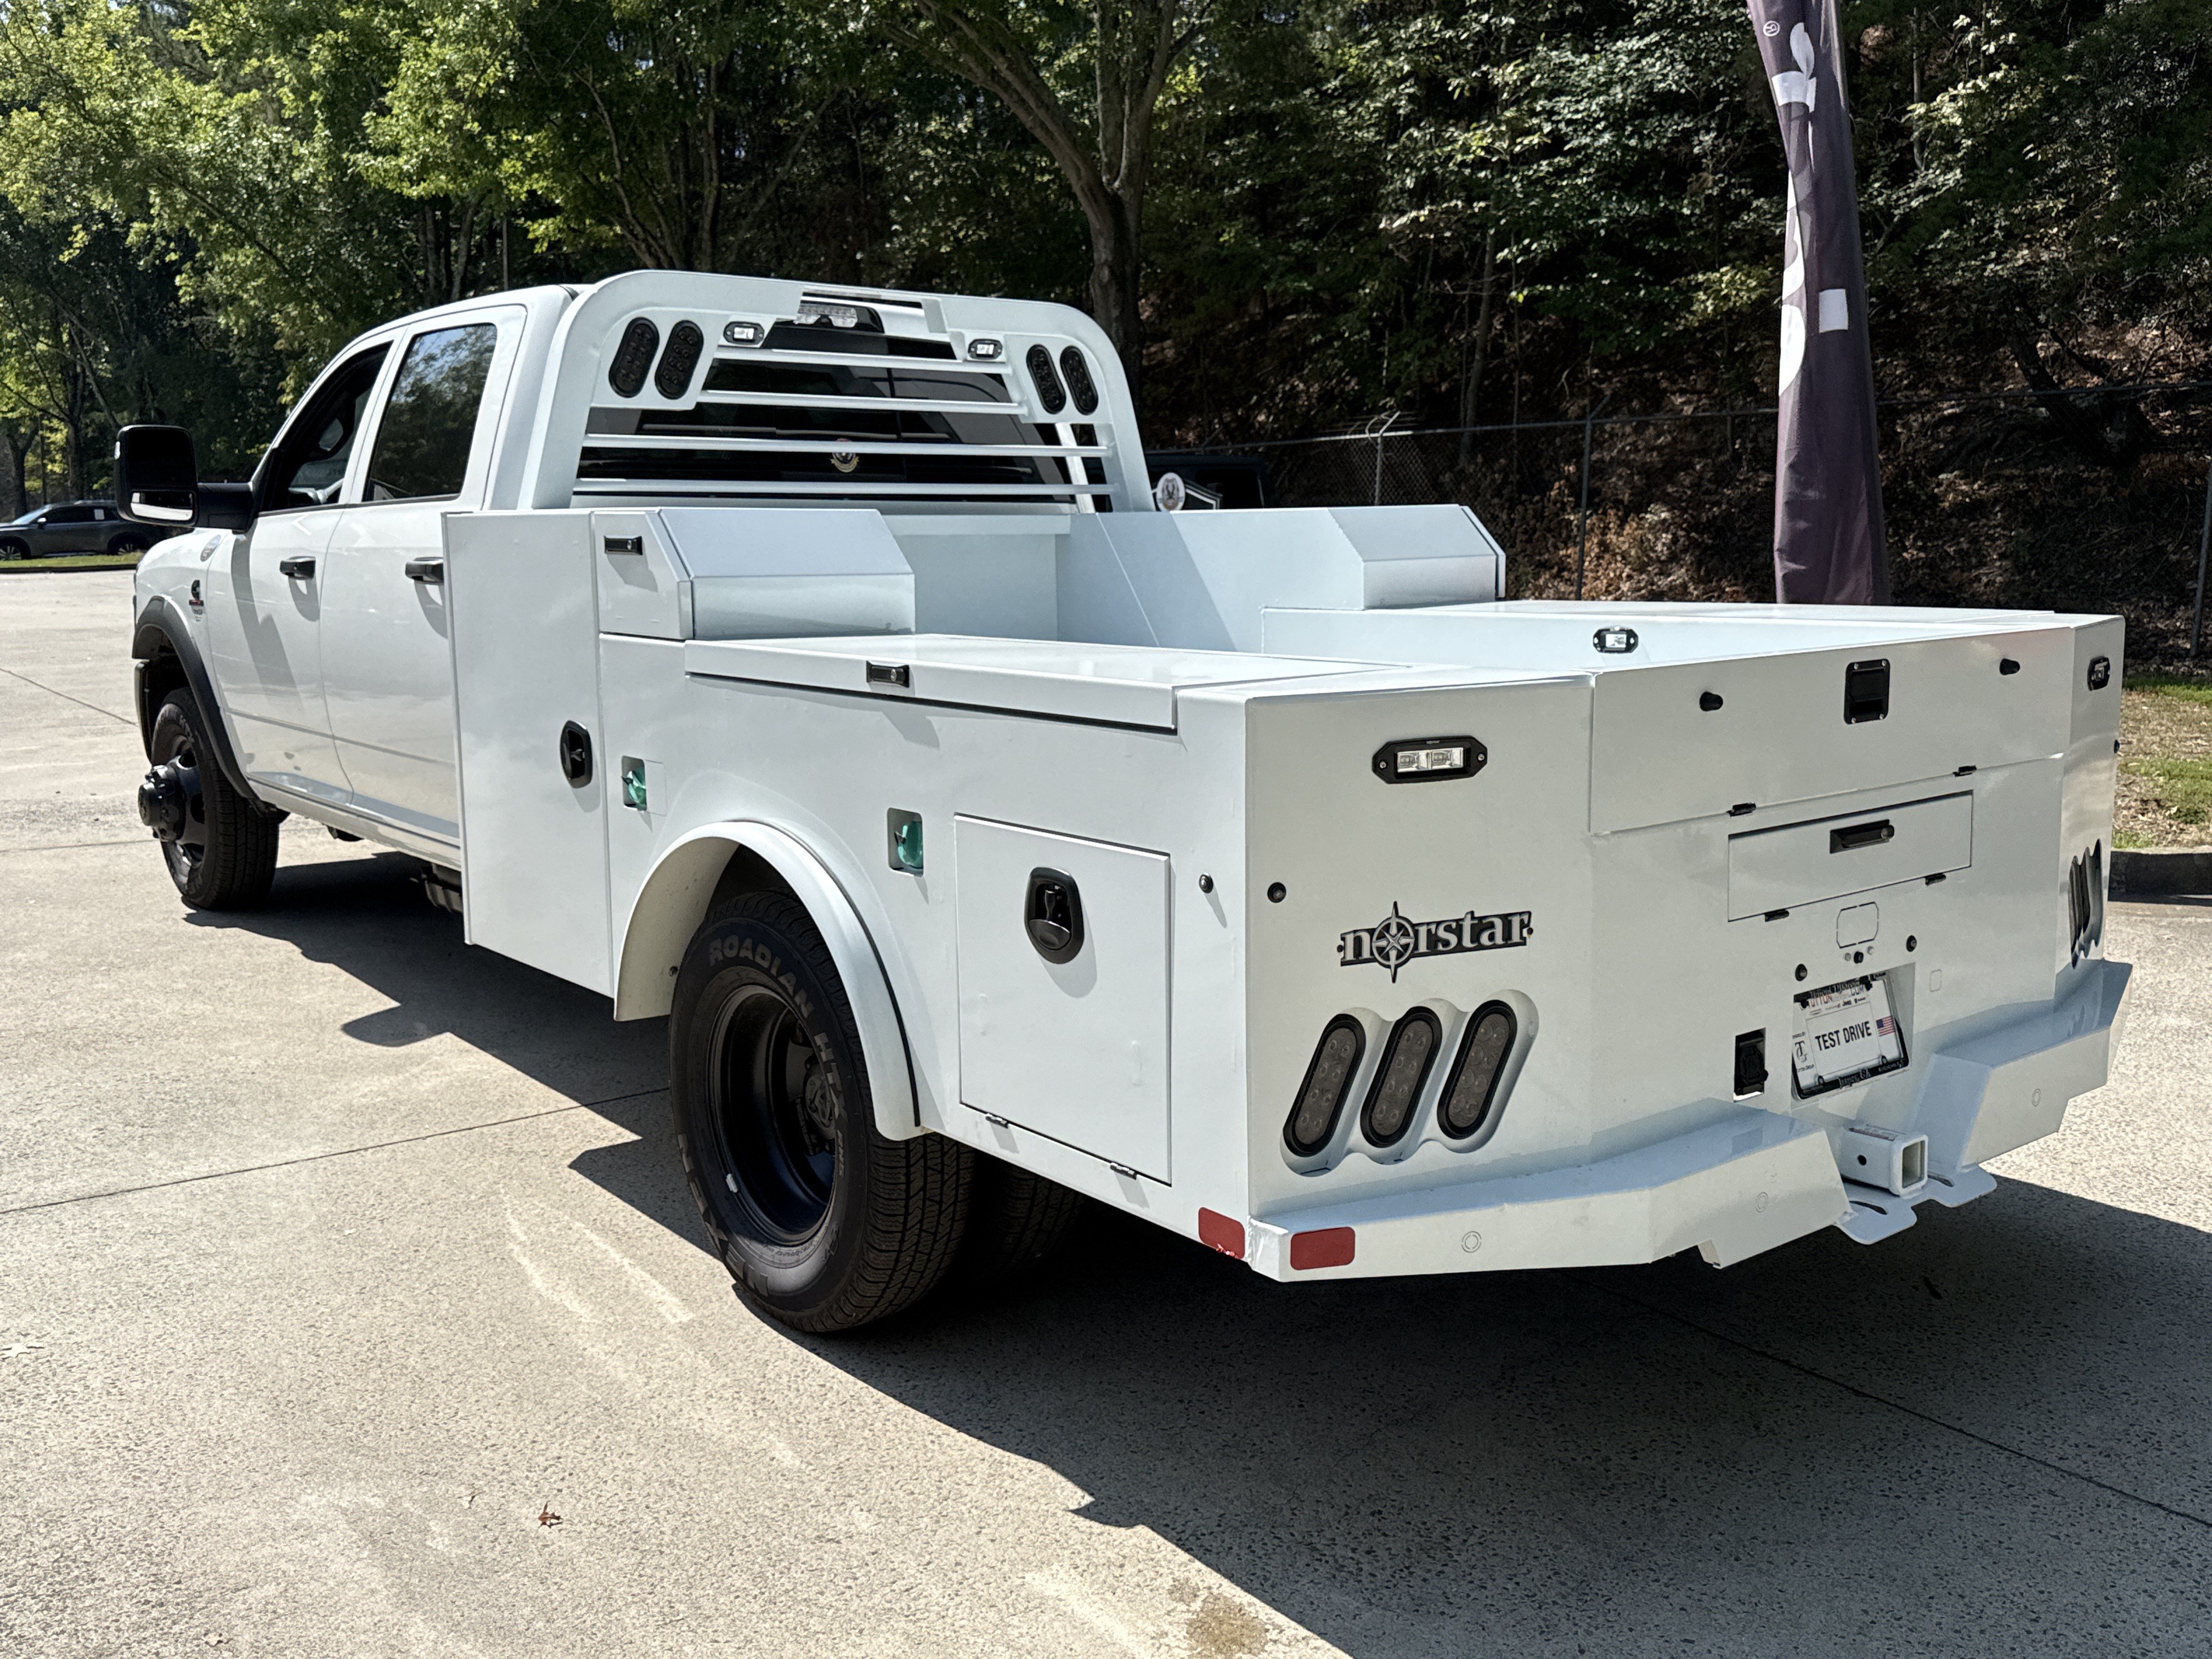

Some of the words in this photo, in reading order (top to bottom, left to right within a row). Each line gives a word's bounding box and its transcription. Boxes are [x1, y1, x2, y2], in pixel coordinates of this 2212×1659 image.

[708, 934, 816, 1019] ROADIAN
[814, 1032, 848, 1123] HTX
[1815, 1030, 1840, 1051] TEST
[1843, 1021, 1872, 1043] DRIVE
